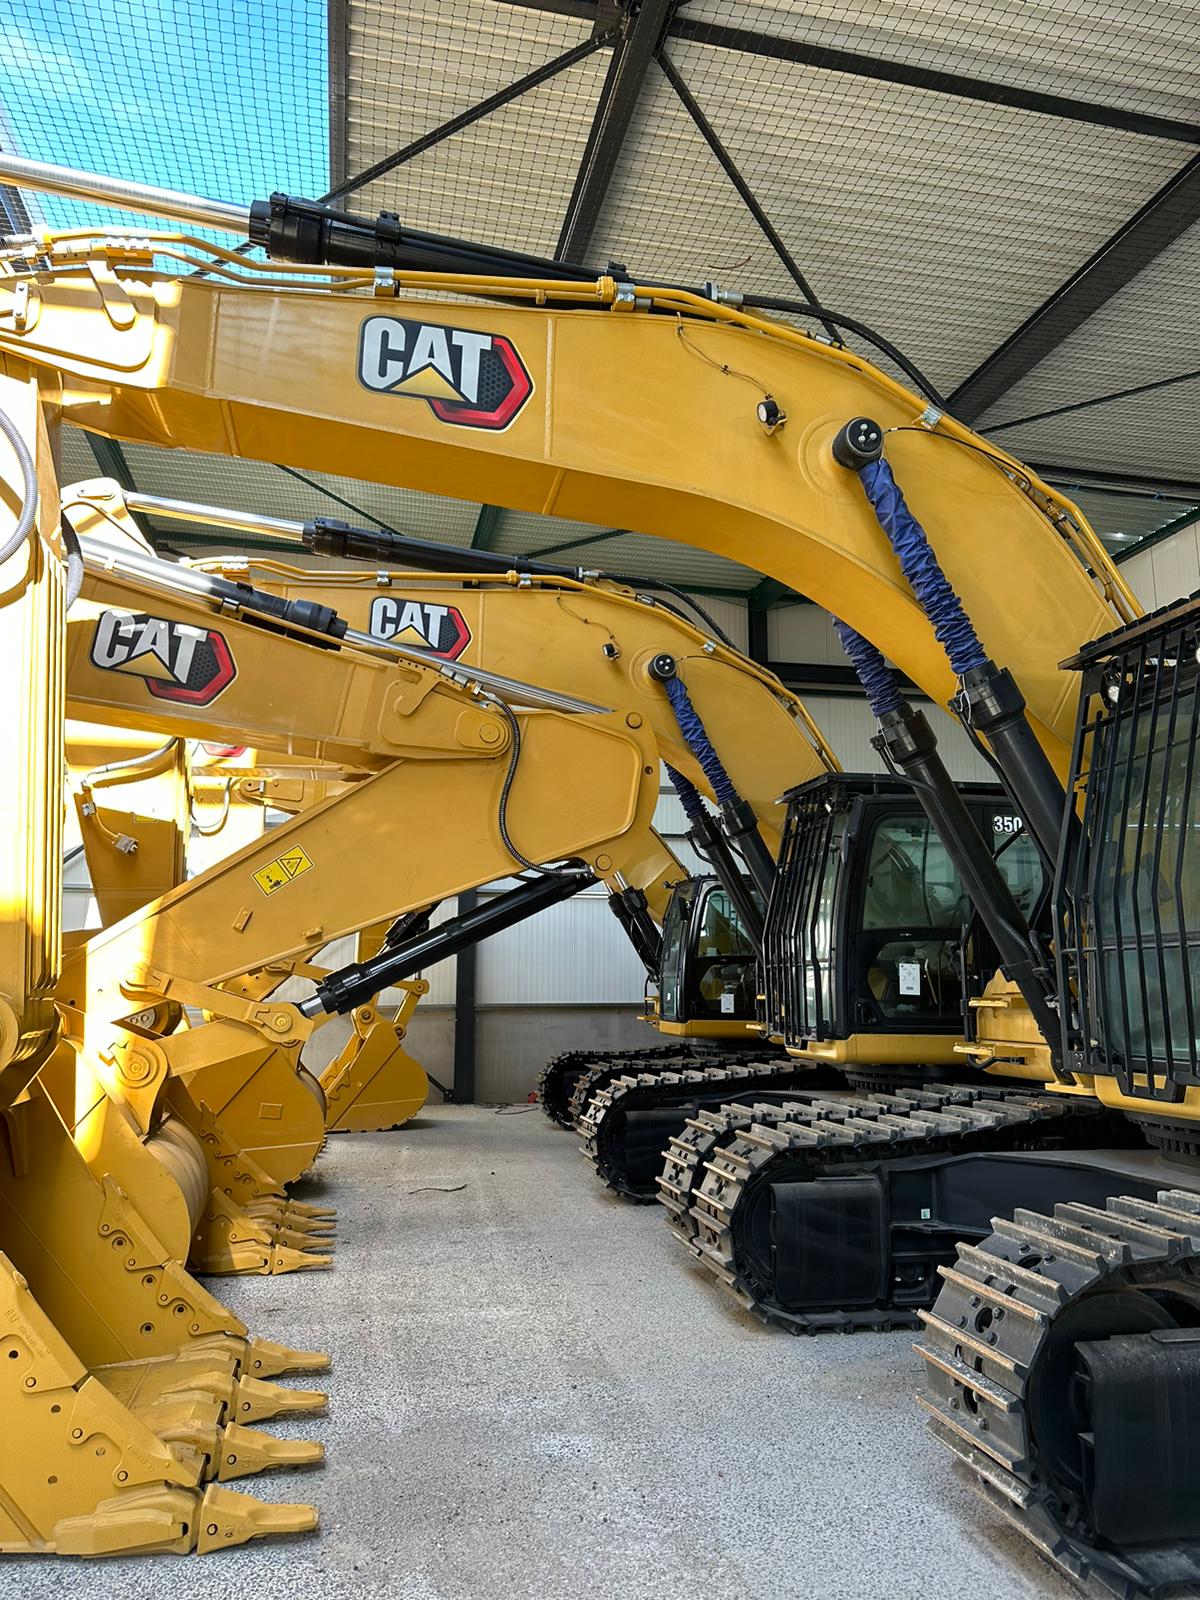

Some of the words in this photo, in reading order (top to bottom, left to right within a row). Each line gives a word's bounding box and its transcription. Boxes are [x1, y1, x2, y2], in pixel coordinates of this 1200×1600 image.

[361, 317, 492, 403] CAT
[93, 608, 208, 684] CAT
[370, 597, 448, 648] CAT
[993, 815, 1023, 833] 350
